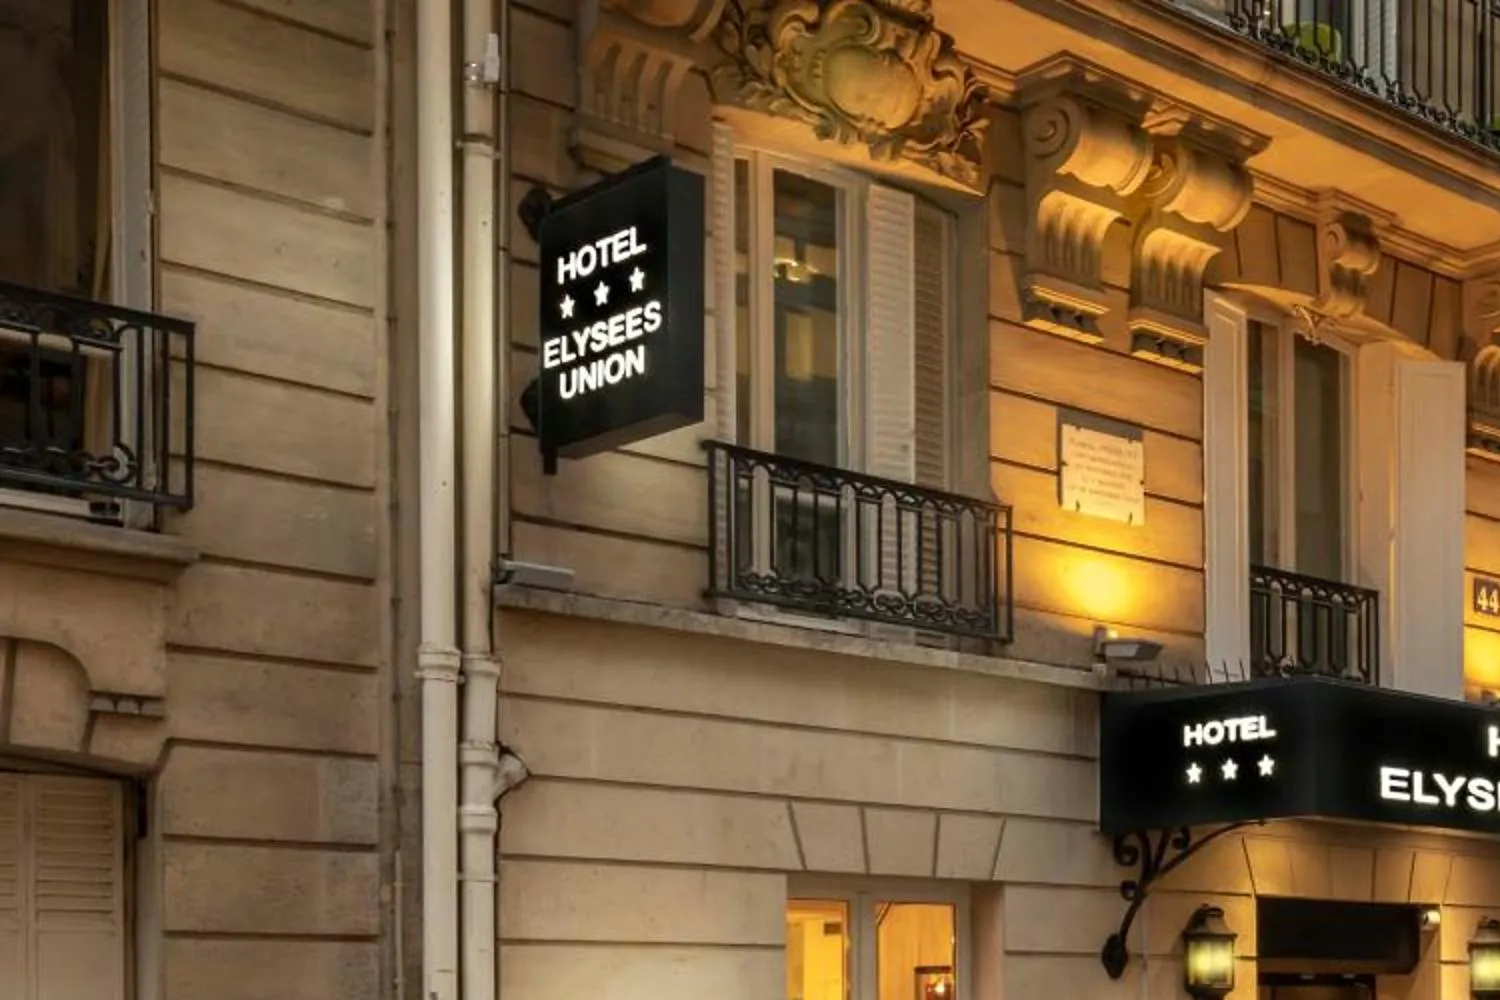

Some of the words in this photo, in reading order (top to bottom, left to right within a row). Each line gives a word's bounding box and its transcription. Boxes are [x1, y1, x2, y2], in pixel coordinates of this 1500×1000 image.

[557, 226, 647, 285] HOTEL
[544, 301, 662, 369] ELYSEES
[560, 344, 645, 399] UNION
[1477, 586, 1499, 613] 44
[1184, 715, 1277, 747] HOTEL
